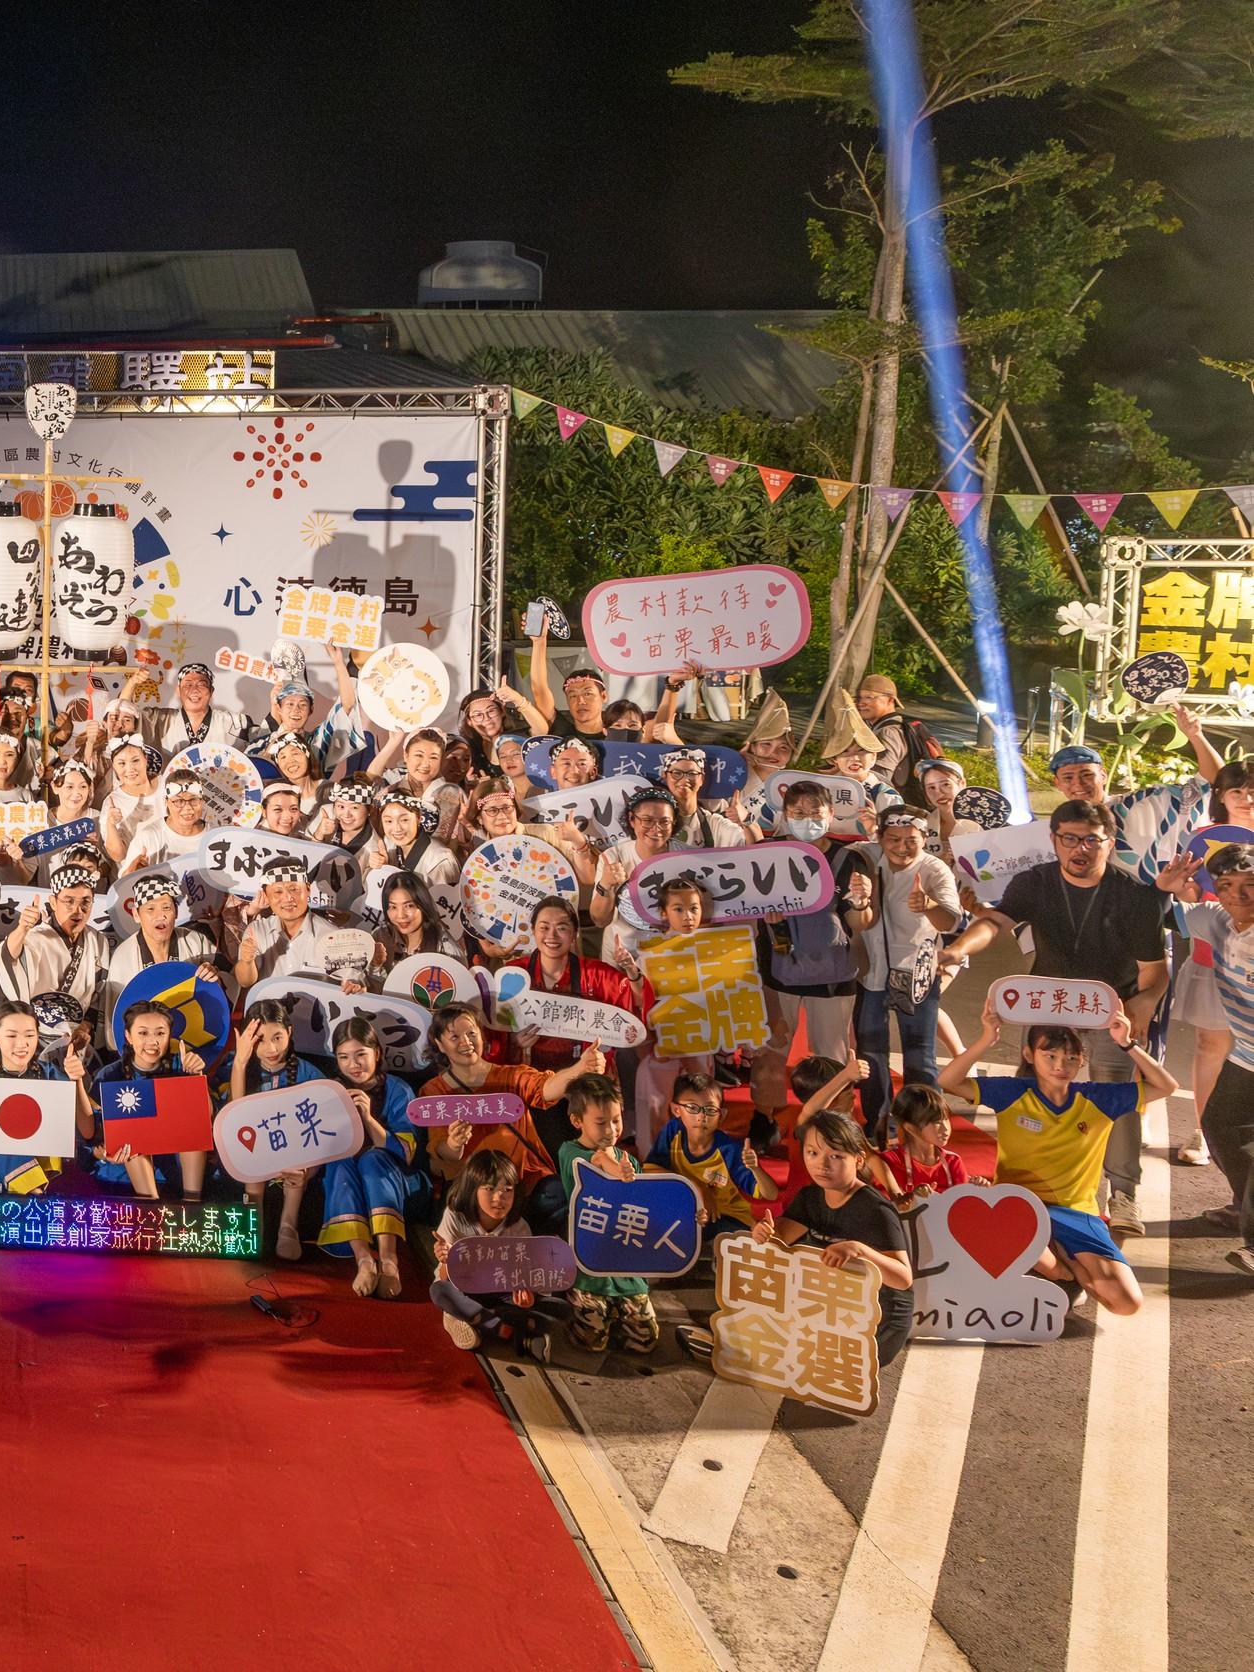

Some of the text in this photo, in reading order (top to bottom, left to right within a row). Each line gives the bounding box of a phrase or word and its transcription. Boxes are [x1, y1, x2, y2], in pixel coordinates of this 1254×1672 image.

[285, 588, 382, 622] 金牌農村
[280, 612, 378, 649] 苗栗金選
[724, 896, 805, 918] subarashii
[648, 986, 771, 1051] 金牌
[1025, 987, 1110, 1015] 苗栗縣
[256, 1097, 337, 1151] 苗栗
[417, 1097, 516, 1120] 苗栗我最美
[576, 1194, 687, 1260] 苗栗人
[725, 1241, 868, 1329] 苗栗
[723, 1309, 867, 1404] 金選
